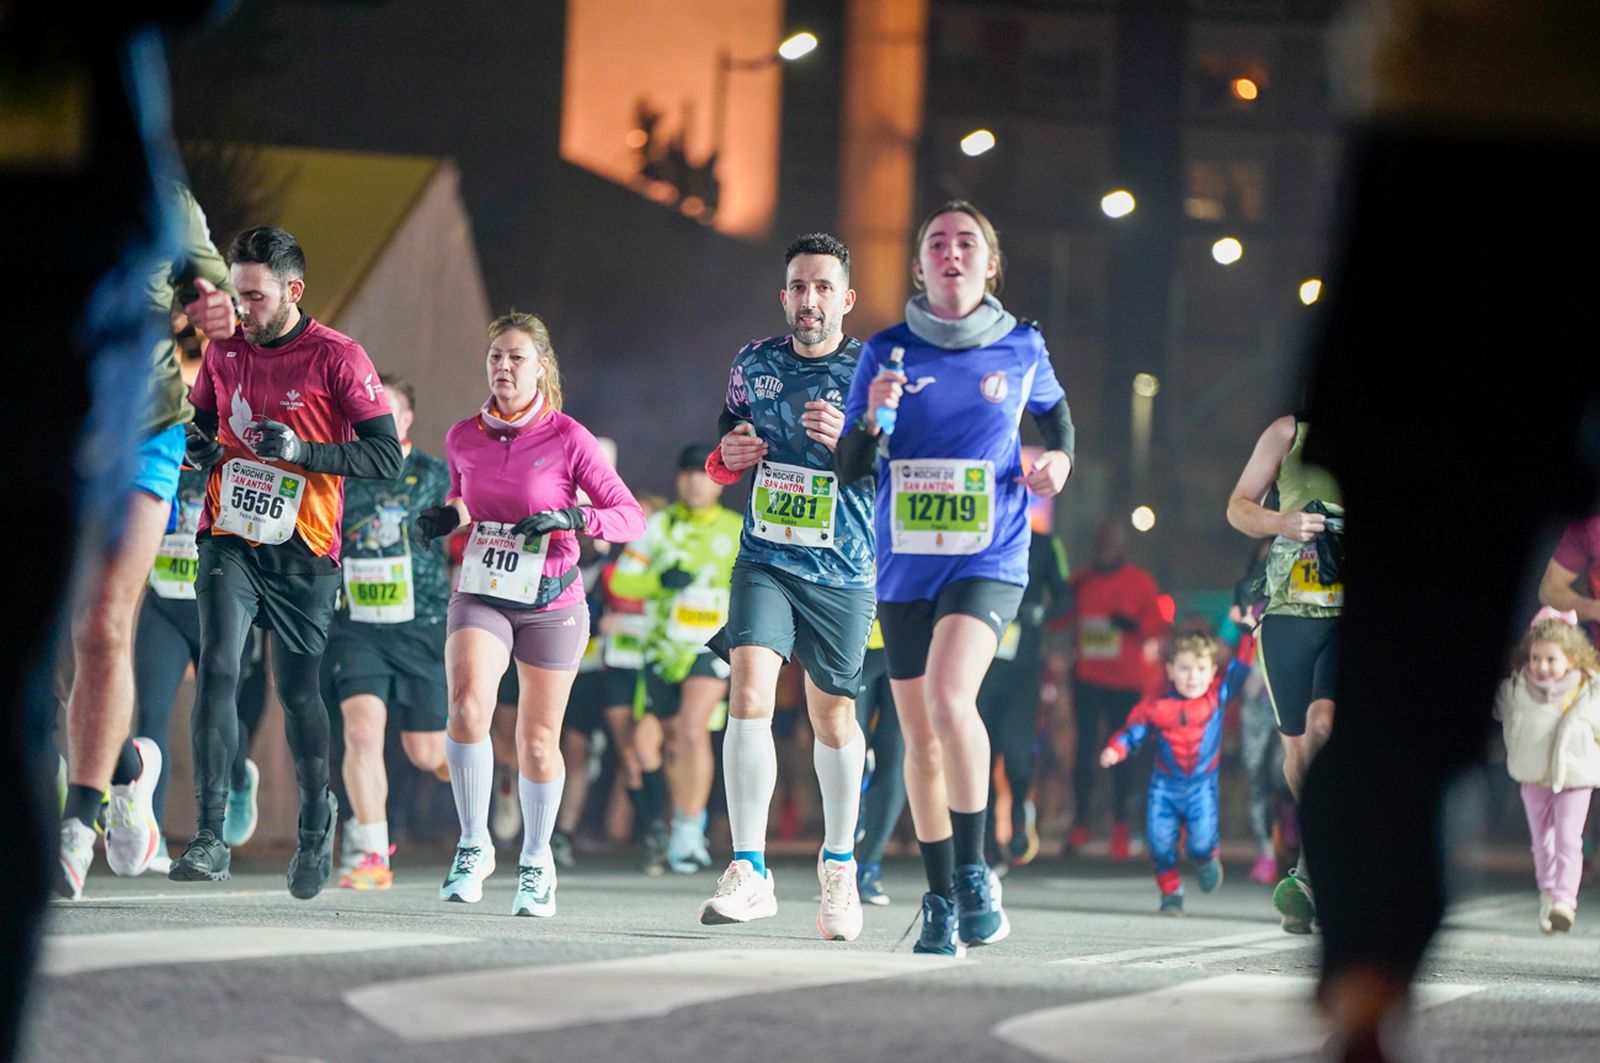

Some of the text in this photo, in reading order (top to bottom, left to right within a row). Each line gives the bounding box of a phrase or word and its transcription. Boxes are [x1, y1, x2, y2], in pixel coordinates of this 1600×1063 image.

[240, 467, 264, 480] NOCHE
[264, 473, 275, 483] DE
[772, 471, 795, 482] NOCHE
[795, 474, 805, 484] DE
[914, 471, 941, 480] NOCHE
[943, 471, 955, 480] DE
[764, 479, 777, 489] SAN
[903, 481, 919, 491] SAN
[231, 486, 285, 519] 5556
[766, 490, 818, 520] 2281
[908, 493, 976, 522] 12719
[482, 547, 519, 573] 410
[358, 583, 398, 600] 6072
